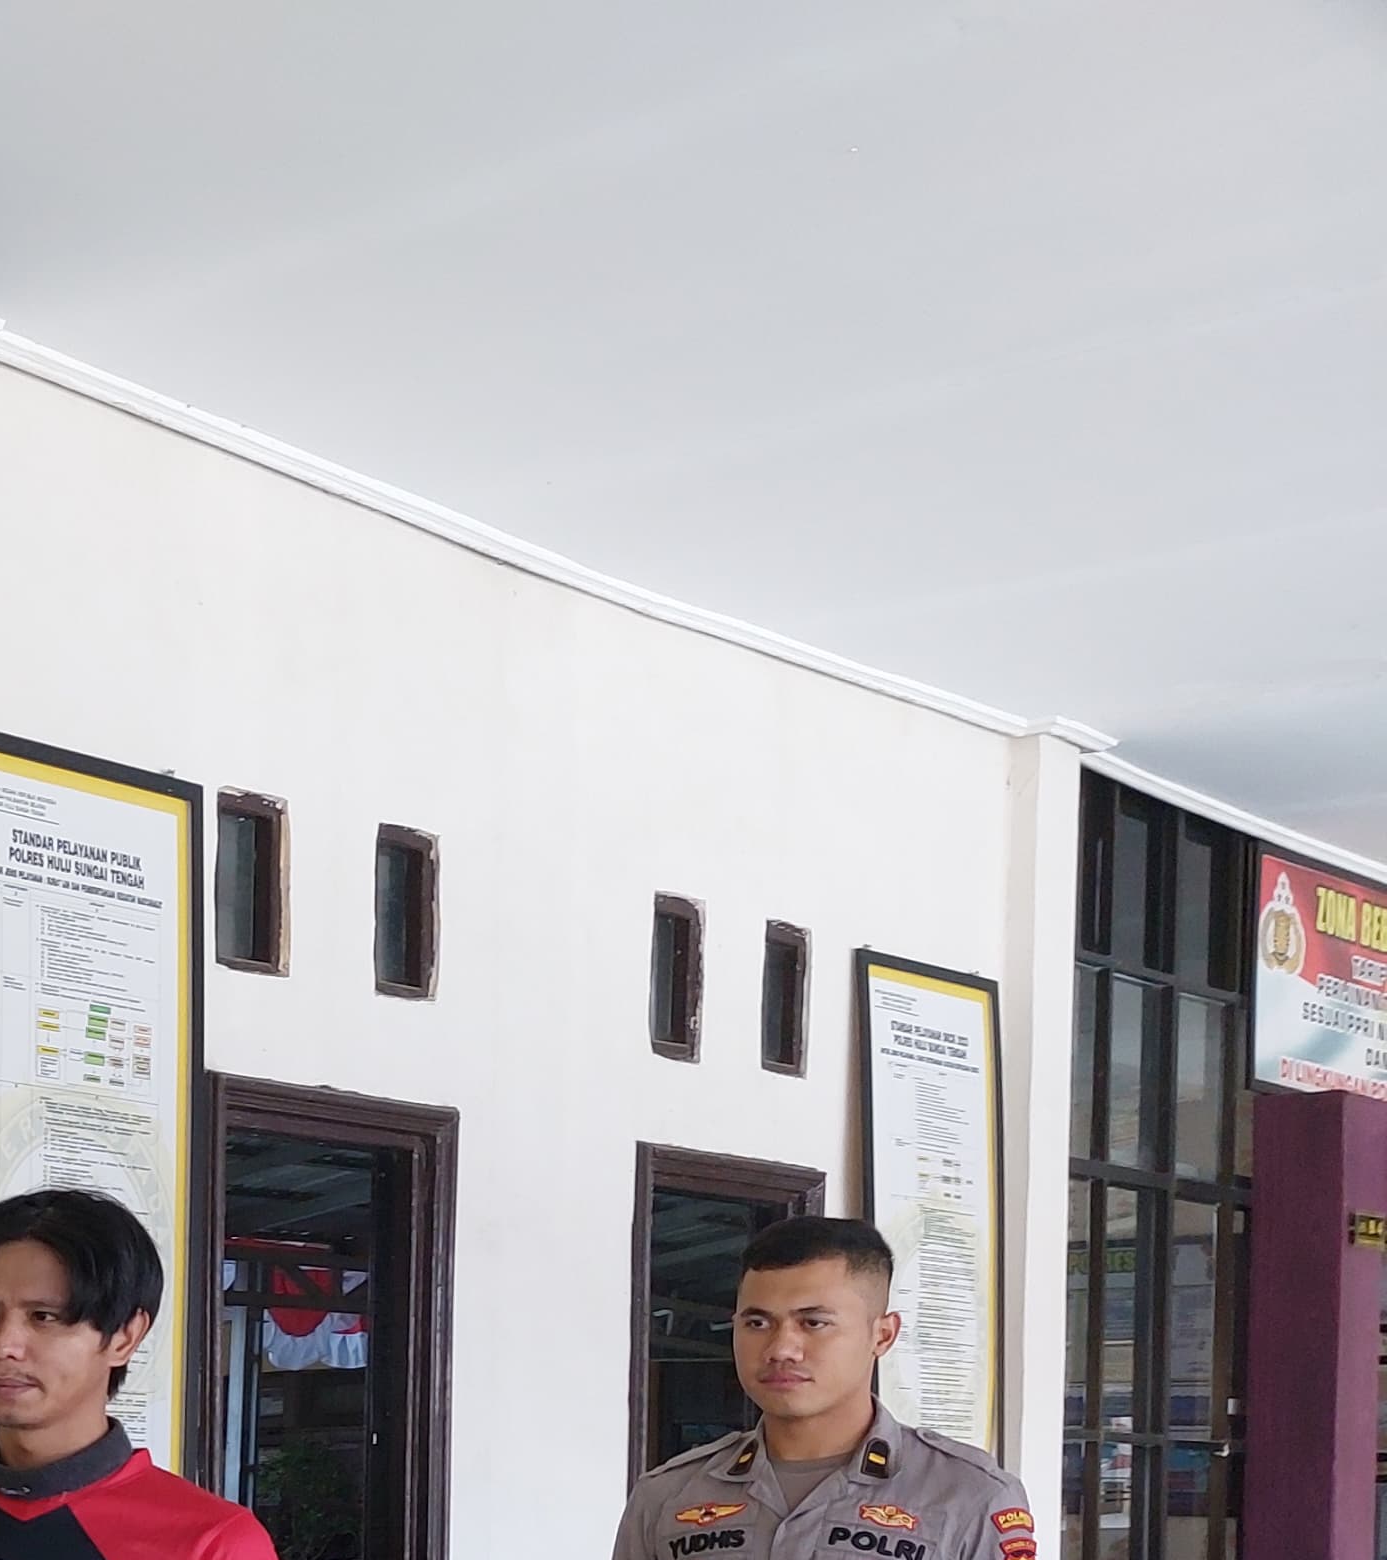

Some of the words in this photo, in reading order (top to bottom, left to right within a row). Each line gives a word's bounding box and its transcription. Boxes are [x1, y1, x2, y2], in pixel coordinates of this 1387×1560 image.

[8, 847, 45, 868] POLRES
[47, 856, 72, 873] HULU
[74, 861, 108, 881] SUNGAI
[110, 869, 145, 890] TENGAH
[12, 829, 54, 851] STANDAR
[56, 838, 108, 863] PELAYANAN
[110, 852, 142, 871] PUBLIK
